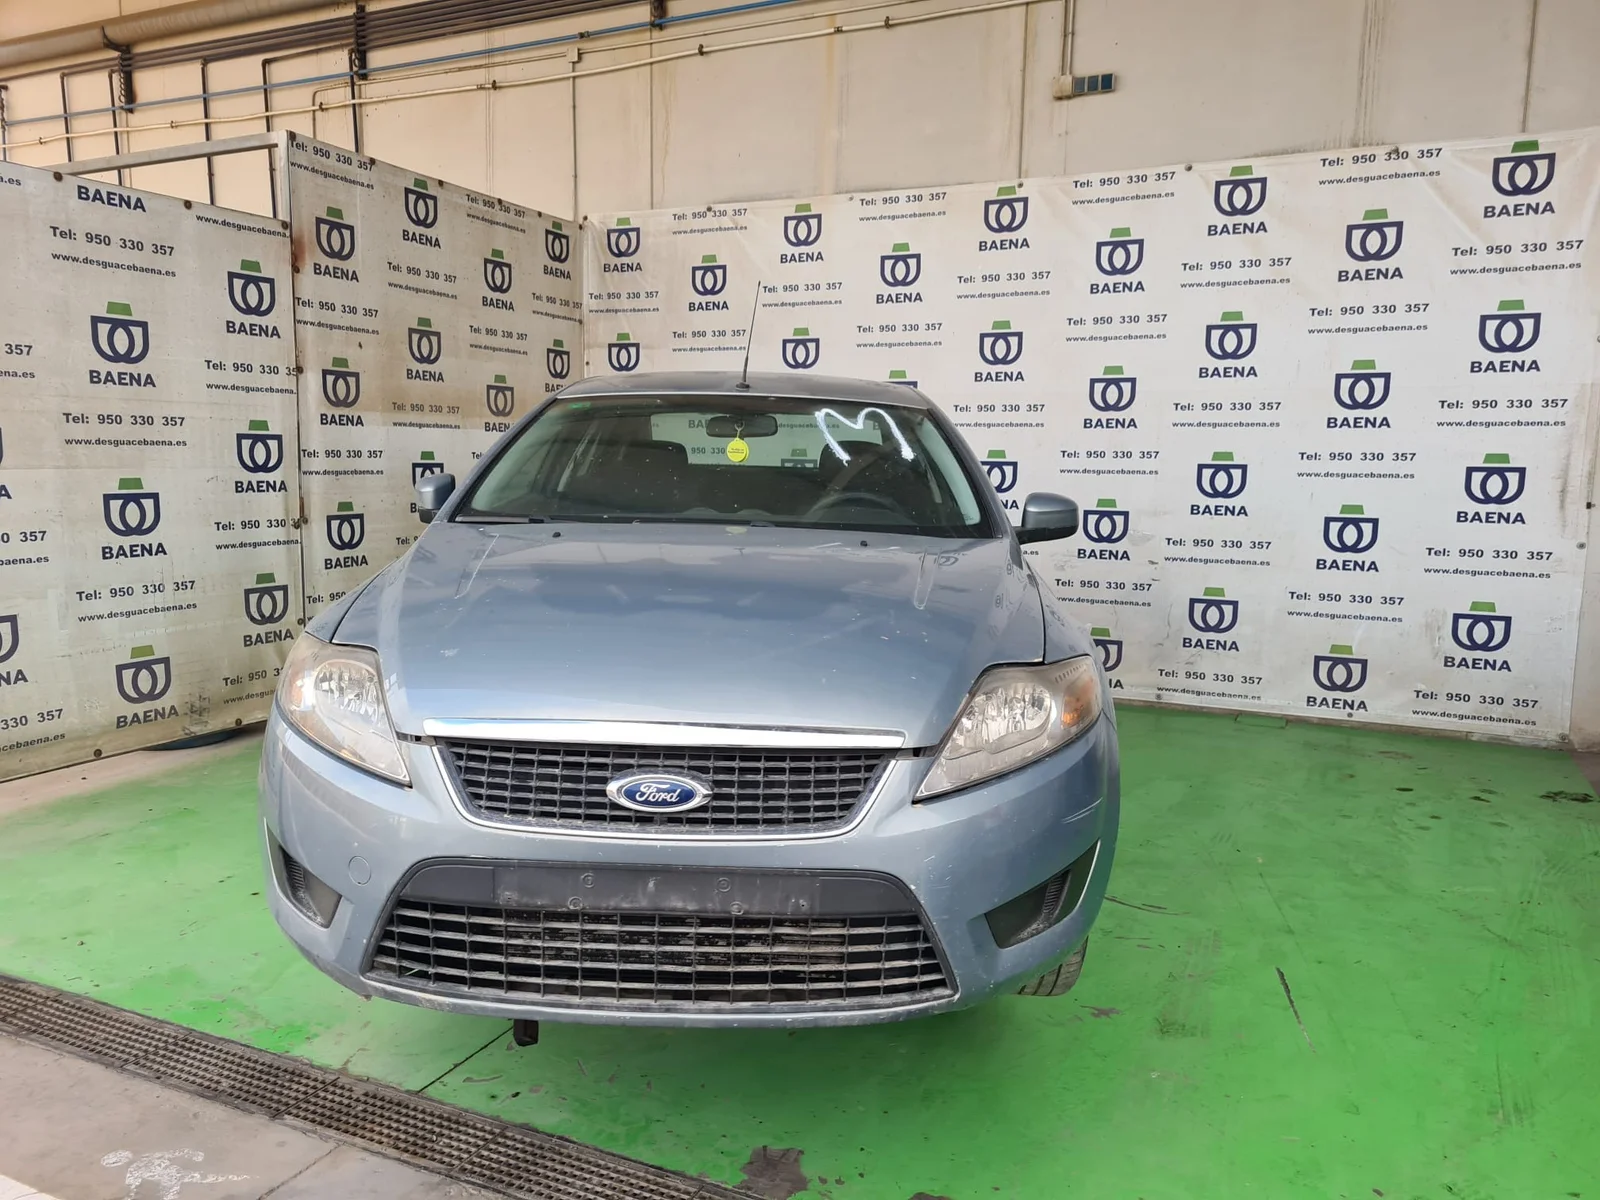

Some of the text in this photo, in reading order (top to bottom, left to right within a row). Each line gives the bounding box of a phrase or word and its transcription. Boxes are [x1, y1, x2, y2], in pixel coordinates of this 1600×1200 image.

[289, 140, 374, 172] Tel: 950 330 357
[1319, 147, 1443, 168] Tel: 950 330 357
[289, 160, 375, 191] www.desguacebaena.es
[1318, 170, 1441, 186] www.desguacebaena.es
[76, 184, 147, 213] BAENA
[859, 191, 947, 207] Tel: 950 330 357
[672, 208, 748, 221] Tel: 950 330 357
[858, 210, 947, 222] www.desguacebaena.es
[1483, 200, 1556, 219] BAENA
[49, 225, 175, 257] Tel: 950 330 357
[402, 228, 442, 250] BAENA
[978, 237, 1031, 252] BAENA
[1451, 239, 1584, 257] Tel: 950 330 357
[779, 250, 825, 264] BAENA
[51, 252, 177, 278] www.desguacebaena.es
[312, 261, 360, 283] BAENA
[386, 261, 457, 284] Tel: 950 330 357
[603, 261, 643, 274] BAENA
[1449, 262, 1582, 275] www.desguacebaena.es
[543, 264, 572, 282] BAENA
[762, 281, 843, 294] Tel: 950 330 357
[1089, 280, 1146, 295] BAENA
[588, 290, 659, 301] Tel: 950 330 357
[295, 297, 379, 319] Tel: 950 330 357
[481, 295, 515, 312] BAENA
[688, 300, 730, 312] BAENA
[1308, 302, 1430, 317] Tel: 950 330 357
[225, 319, 282, 340] BAENA
[295, 317, 380, 336] www.desguacebaena.es
[469, 325, 528, 342] Tel: 950 330 357
[1307, 324, 1428, 335] www.desguacebaena.es
[4, 342, 33, 357] 357
[203, 359, 280, 376] Tel: 950 330
[1469, 359, 1541, 374] BAENA
[88, 369, 157, 388] BAENA
[406, 367, 445, 383] BAENA
[974, 370, 1025, 383] BAENA
[391, 402, 460, 415] Tel: 950 330 357
[1438, 398, 1569, 410] Tel: 950 330 357
[61, 412, 186, 427] Tel: 950 330 357
[319, 412, 365, 428] BAENA
[1436, 419, 1566, 429] www.desguacebaena.es
[64, 437, 188, 448] www.desguacebaena.es
[301, 448, 384, 459] Tel: 950 330 357
[1060, 450, 1160, 460] Tel: 950 330 357
[302, 468, 384, 477] www.desguacebaena.es
[1059, 467, 1159, 476] www.desguacebaena.es
[234, 479, 289, 494] BAENA
[213, 518, 287, 532] Tel: 950 330
[1455, 510, 1527, 525] BAENA
[19, 530, 48, 543] 357
[1164, 537, 1272, 550] Tel: 950 330 357
[101, 542, 168, 561] BAENA
[1076, 547, 1131, 562] BAENA
[1425, 547, 1554, 561] Tel: 950 330 357
[324, 554, 369, 571] BAENA
[1163, 556, 1271, 567] www.desguacebaena.es
[1315, 558, 1380, 573] BAENA
[75, 579, 196, 602] Tel: 950 330 357
[1054, 578, 1153, 592] Tel: 950 330 357
[305, 594, 325, 605] Tel:
[77, 602, 198, 623] www.desguacebaena.es
[242, 627, 295, 648] BAENA
[1182, 636, 1240, 653] BAENA
[221, 669, 268, 687] Tel: 950
[1413, 689, 1539, 709] Tel: 950 330 357
[0, 707, 64, 731] 330 357
[115, 704, 180, 730] BAENA
[1411, 709, 1537, 727] www.desguacebaena.es
[635, 783, 681, 802] Ford
